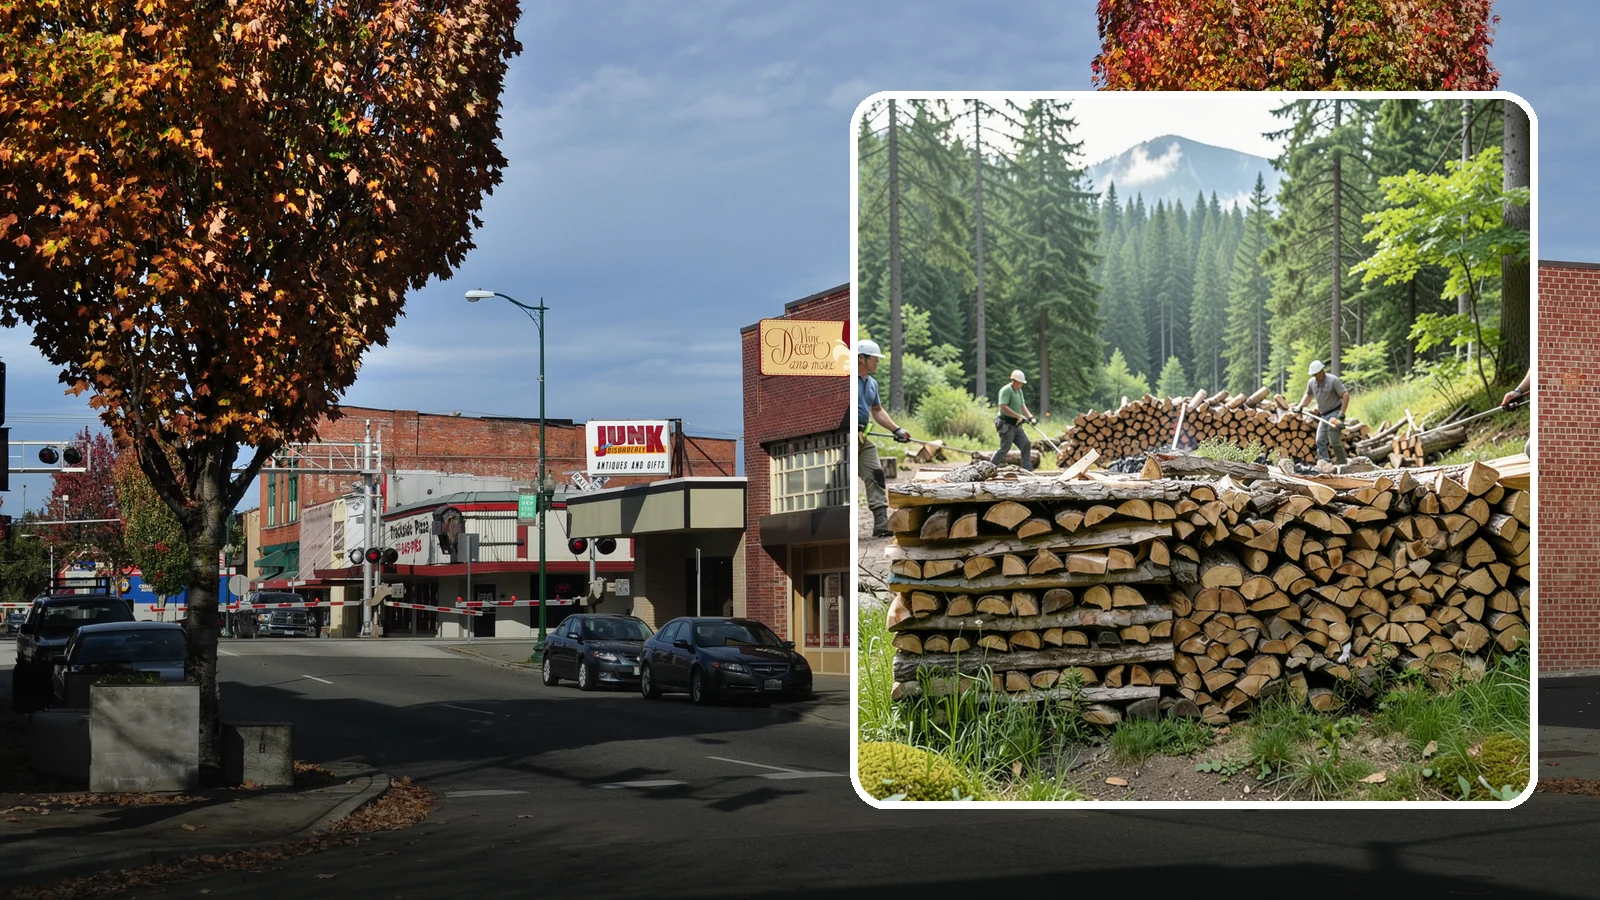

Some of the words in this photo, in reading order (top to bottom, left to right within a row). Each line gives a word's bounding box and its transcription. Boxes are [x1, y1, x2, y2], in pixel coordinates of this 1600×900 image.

[596, 425, 665, 457] JUNK
[607, 446, 646, 454] DISORDERLY
[597, 461, 628, 470] ANTIQUES
[631, 461, 644, 470] AND
[647, 460, 665, 469] GIFTS
[414, 519, 429, 535] Pizza
